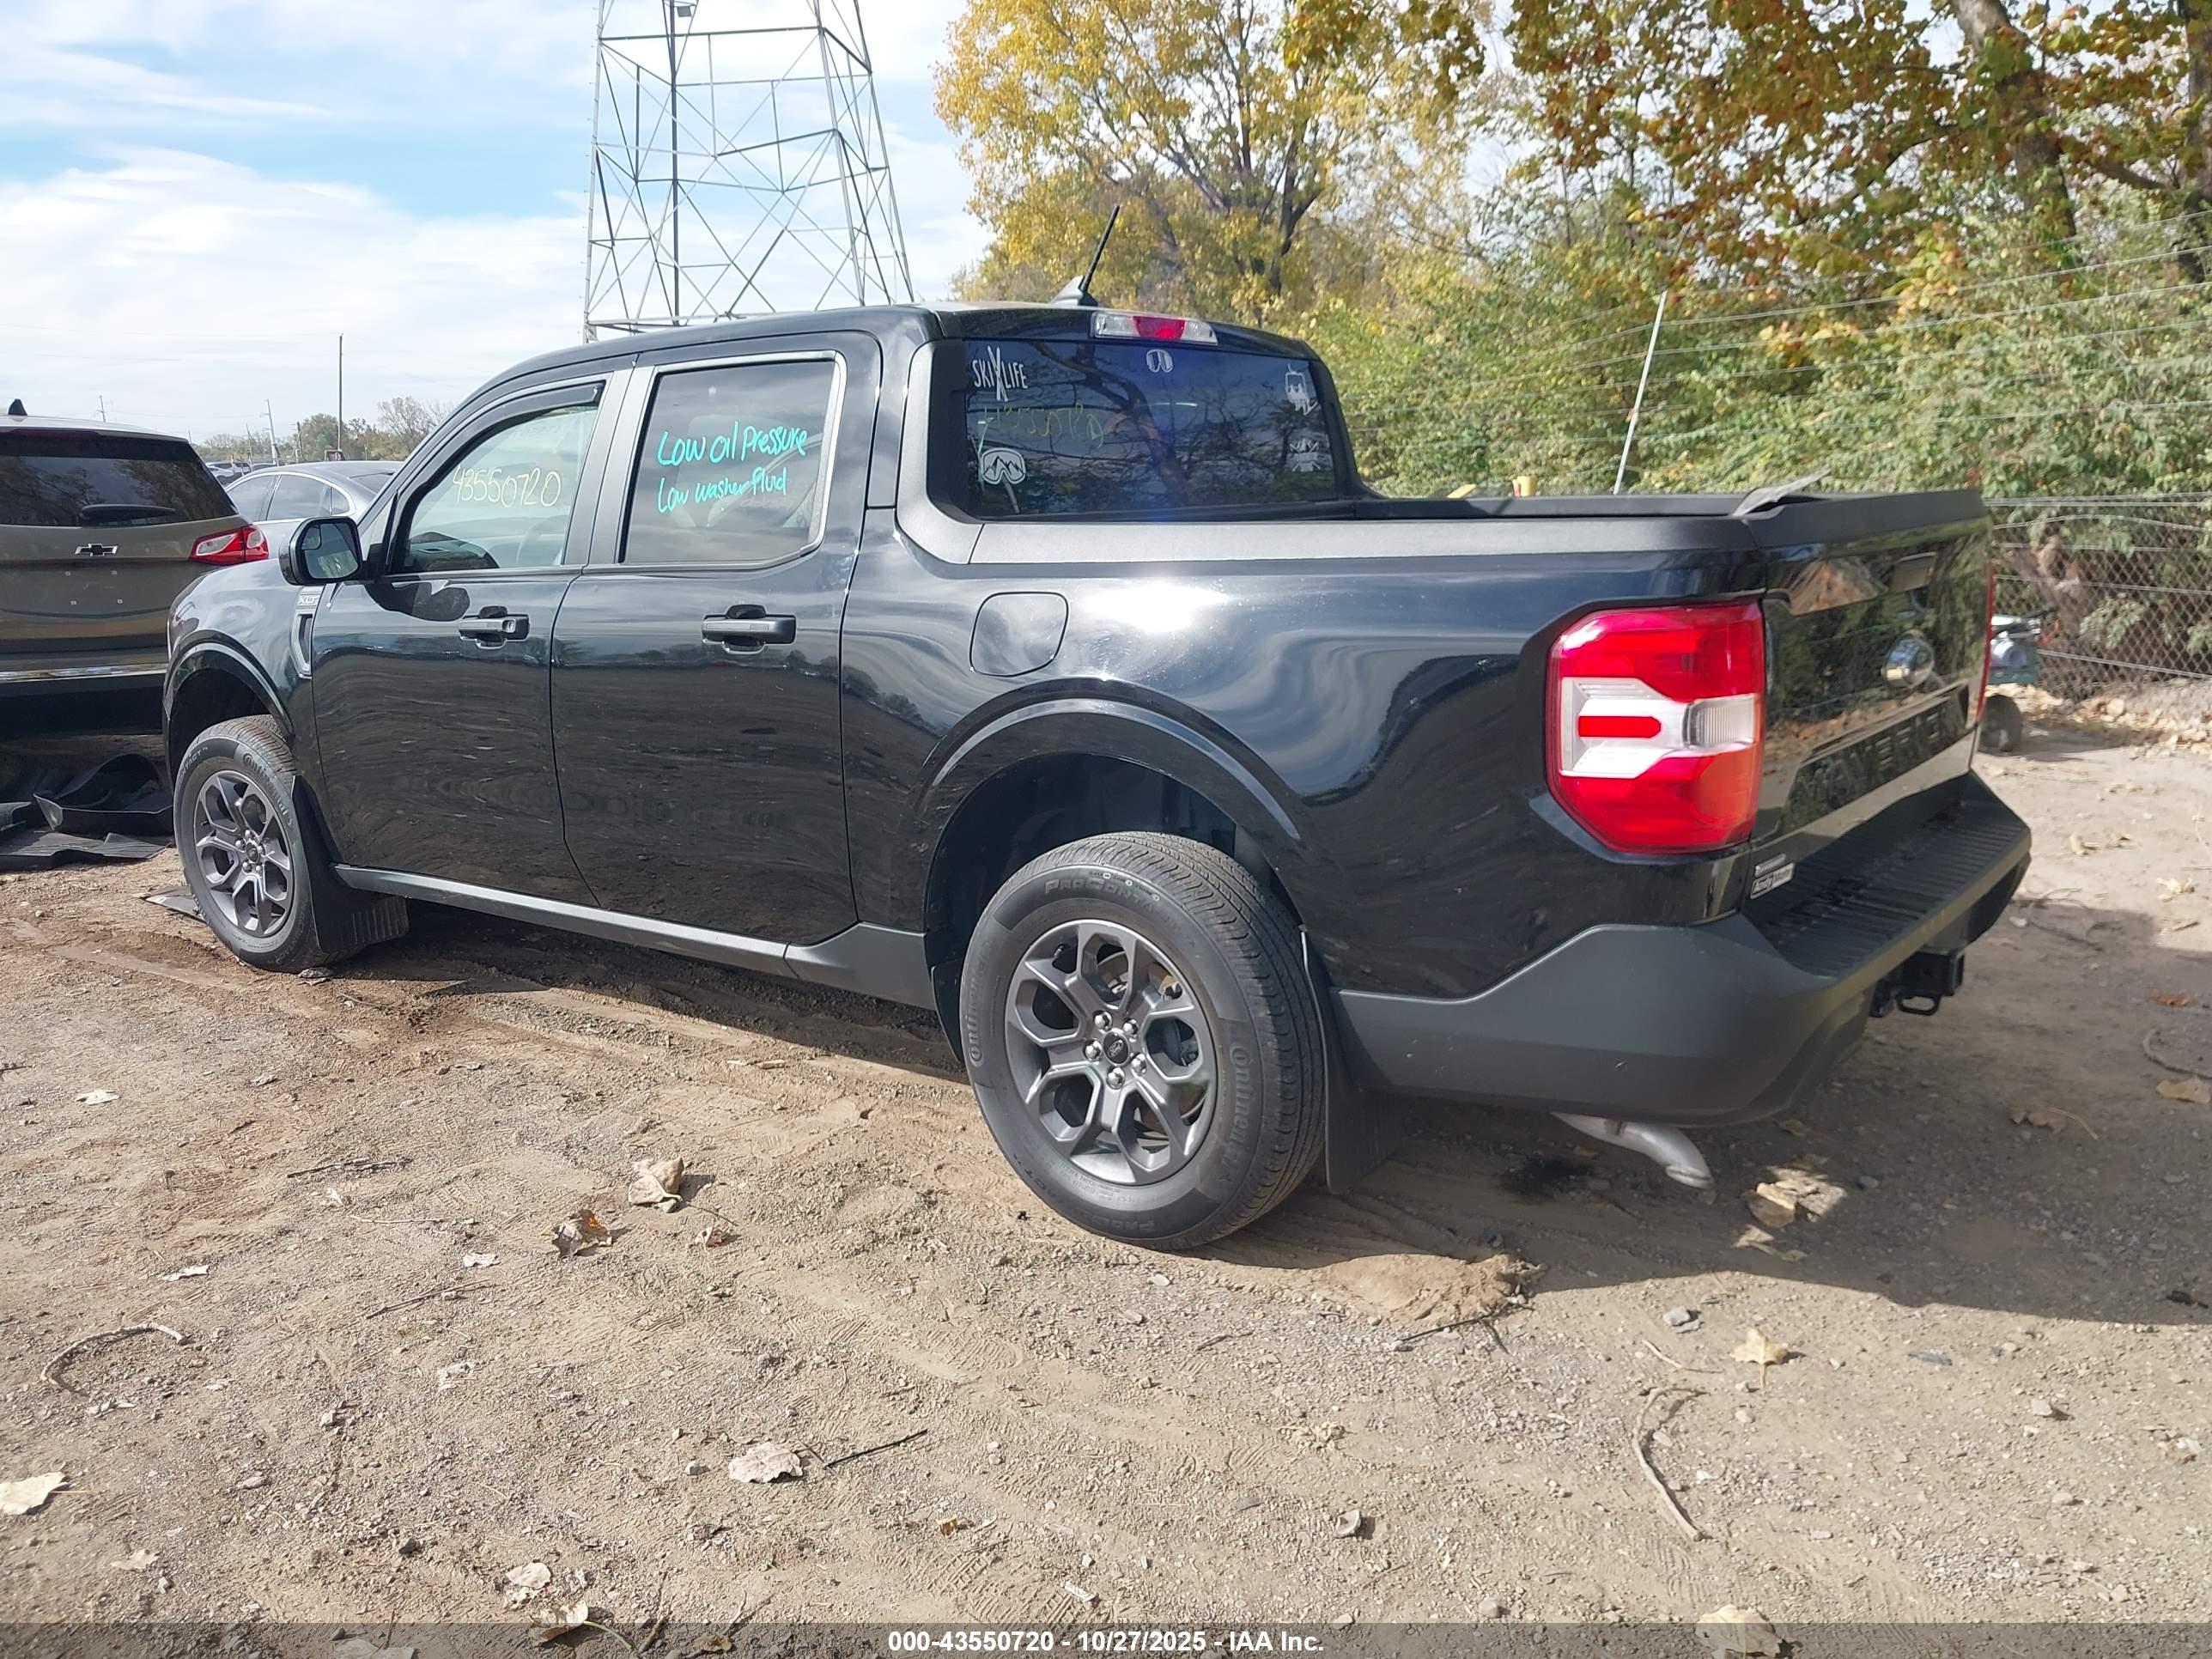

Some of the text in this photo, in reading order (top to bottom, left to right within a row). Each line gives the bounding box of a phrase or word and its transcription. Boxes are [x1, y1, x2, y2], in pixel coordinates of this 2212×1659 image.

[972, 357, 1029, 389] SKI LIFE
[453, 465, 562, 508] 43550720
[297, 594, 319, 605] XLT
